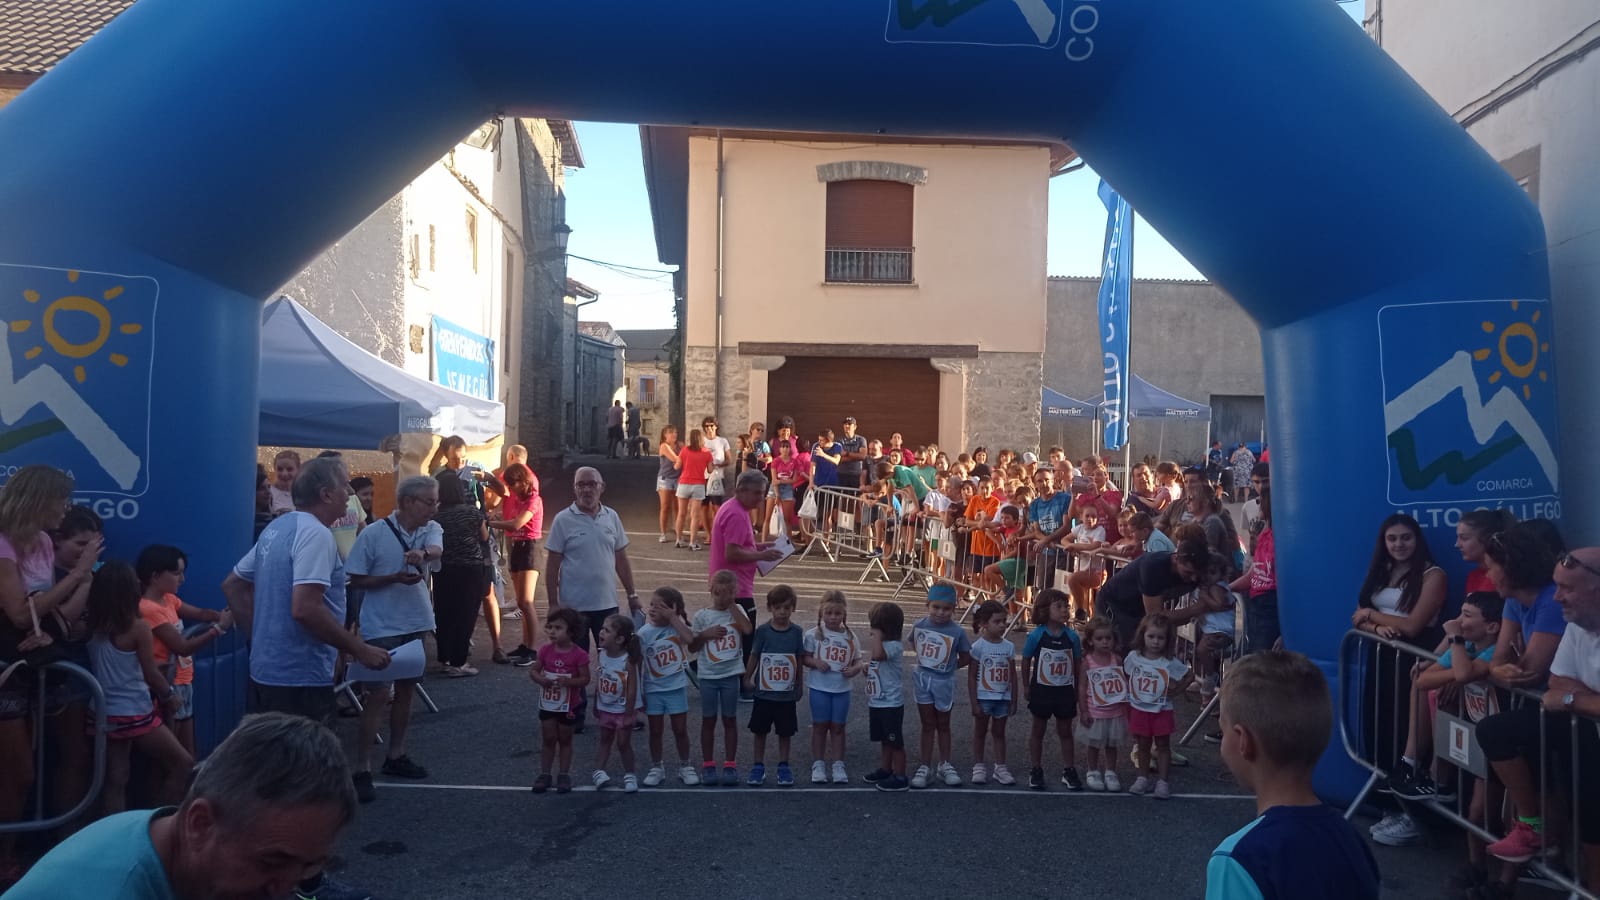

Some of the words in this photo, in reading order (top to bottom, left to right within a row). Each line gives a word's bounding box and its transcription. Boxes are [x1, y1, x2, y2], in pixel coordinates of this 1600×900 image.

[1065, 0, 1099, 61] CO
[1476, 478, 1533, 492] COMARCA
[1394, 508, 1463, 528] LTO
[714, 634, 737, 652] 123
[655, 650, 678, 668] 124
[825, 646, 847, 663] 133
[921, 643, 941, 660] 151
[767, 666, 790, 682] 136
[989, 668, 1009, 683] 138
[1049, 662, 1068, 676] 147
[1100, 680, 1123, 695] 120
[1137, 678, 1158, 694] 121
